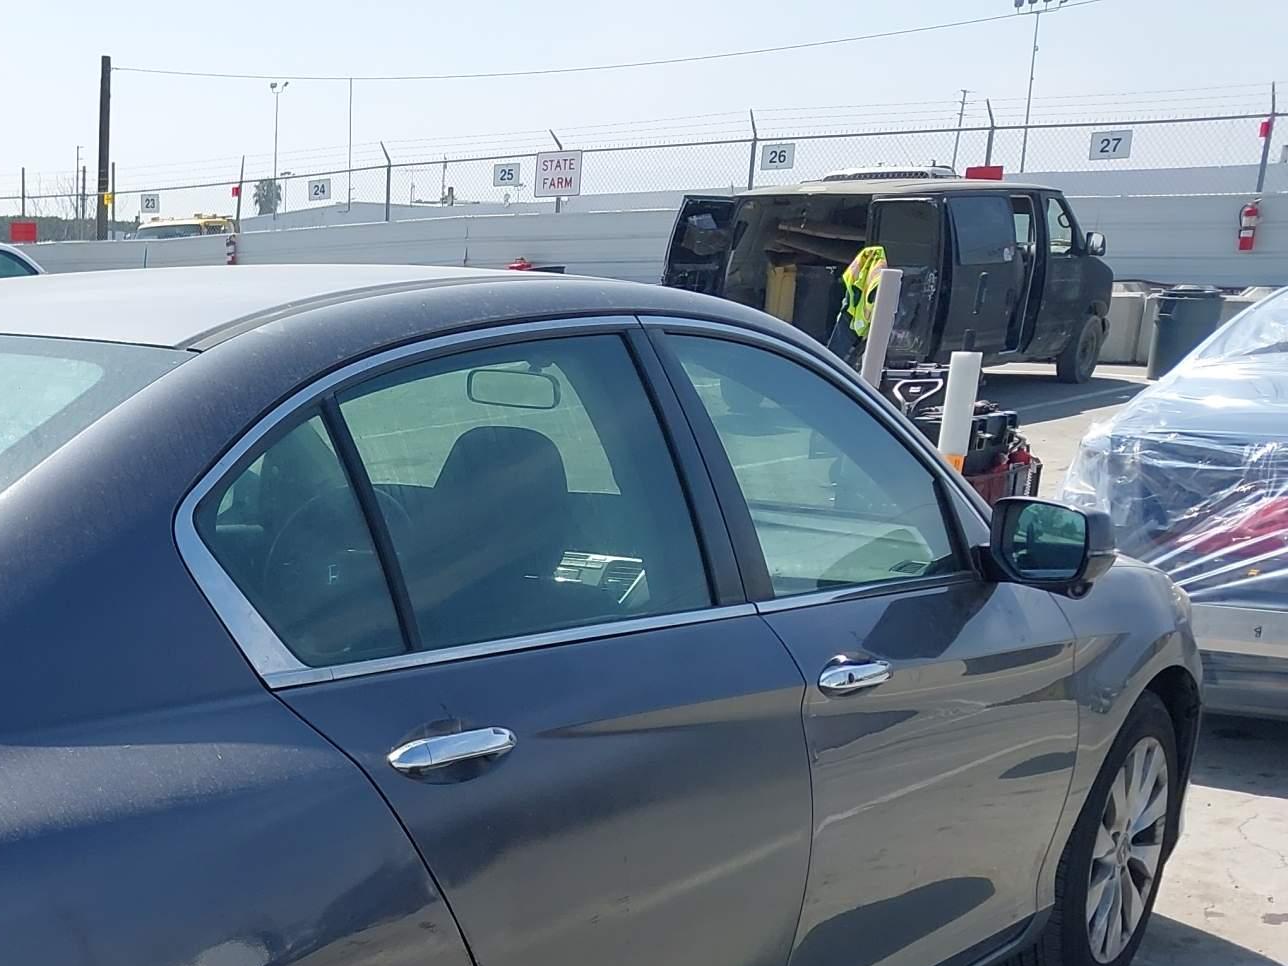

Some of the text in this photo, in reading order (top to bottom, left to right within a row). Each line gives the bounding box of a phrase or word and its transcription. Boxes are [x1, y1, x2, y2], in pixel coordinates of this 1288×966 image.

[1098, 137, 1123, 153] 27
[768, 149, 787, 164] 26
[541, 158, 576, 172] STATE
[499, 168, 514, 181] 25
[313, 183, 326, 196] 24
[541, 176, 573, 190] FARM
[144, 198, 156, 209] 23
